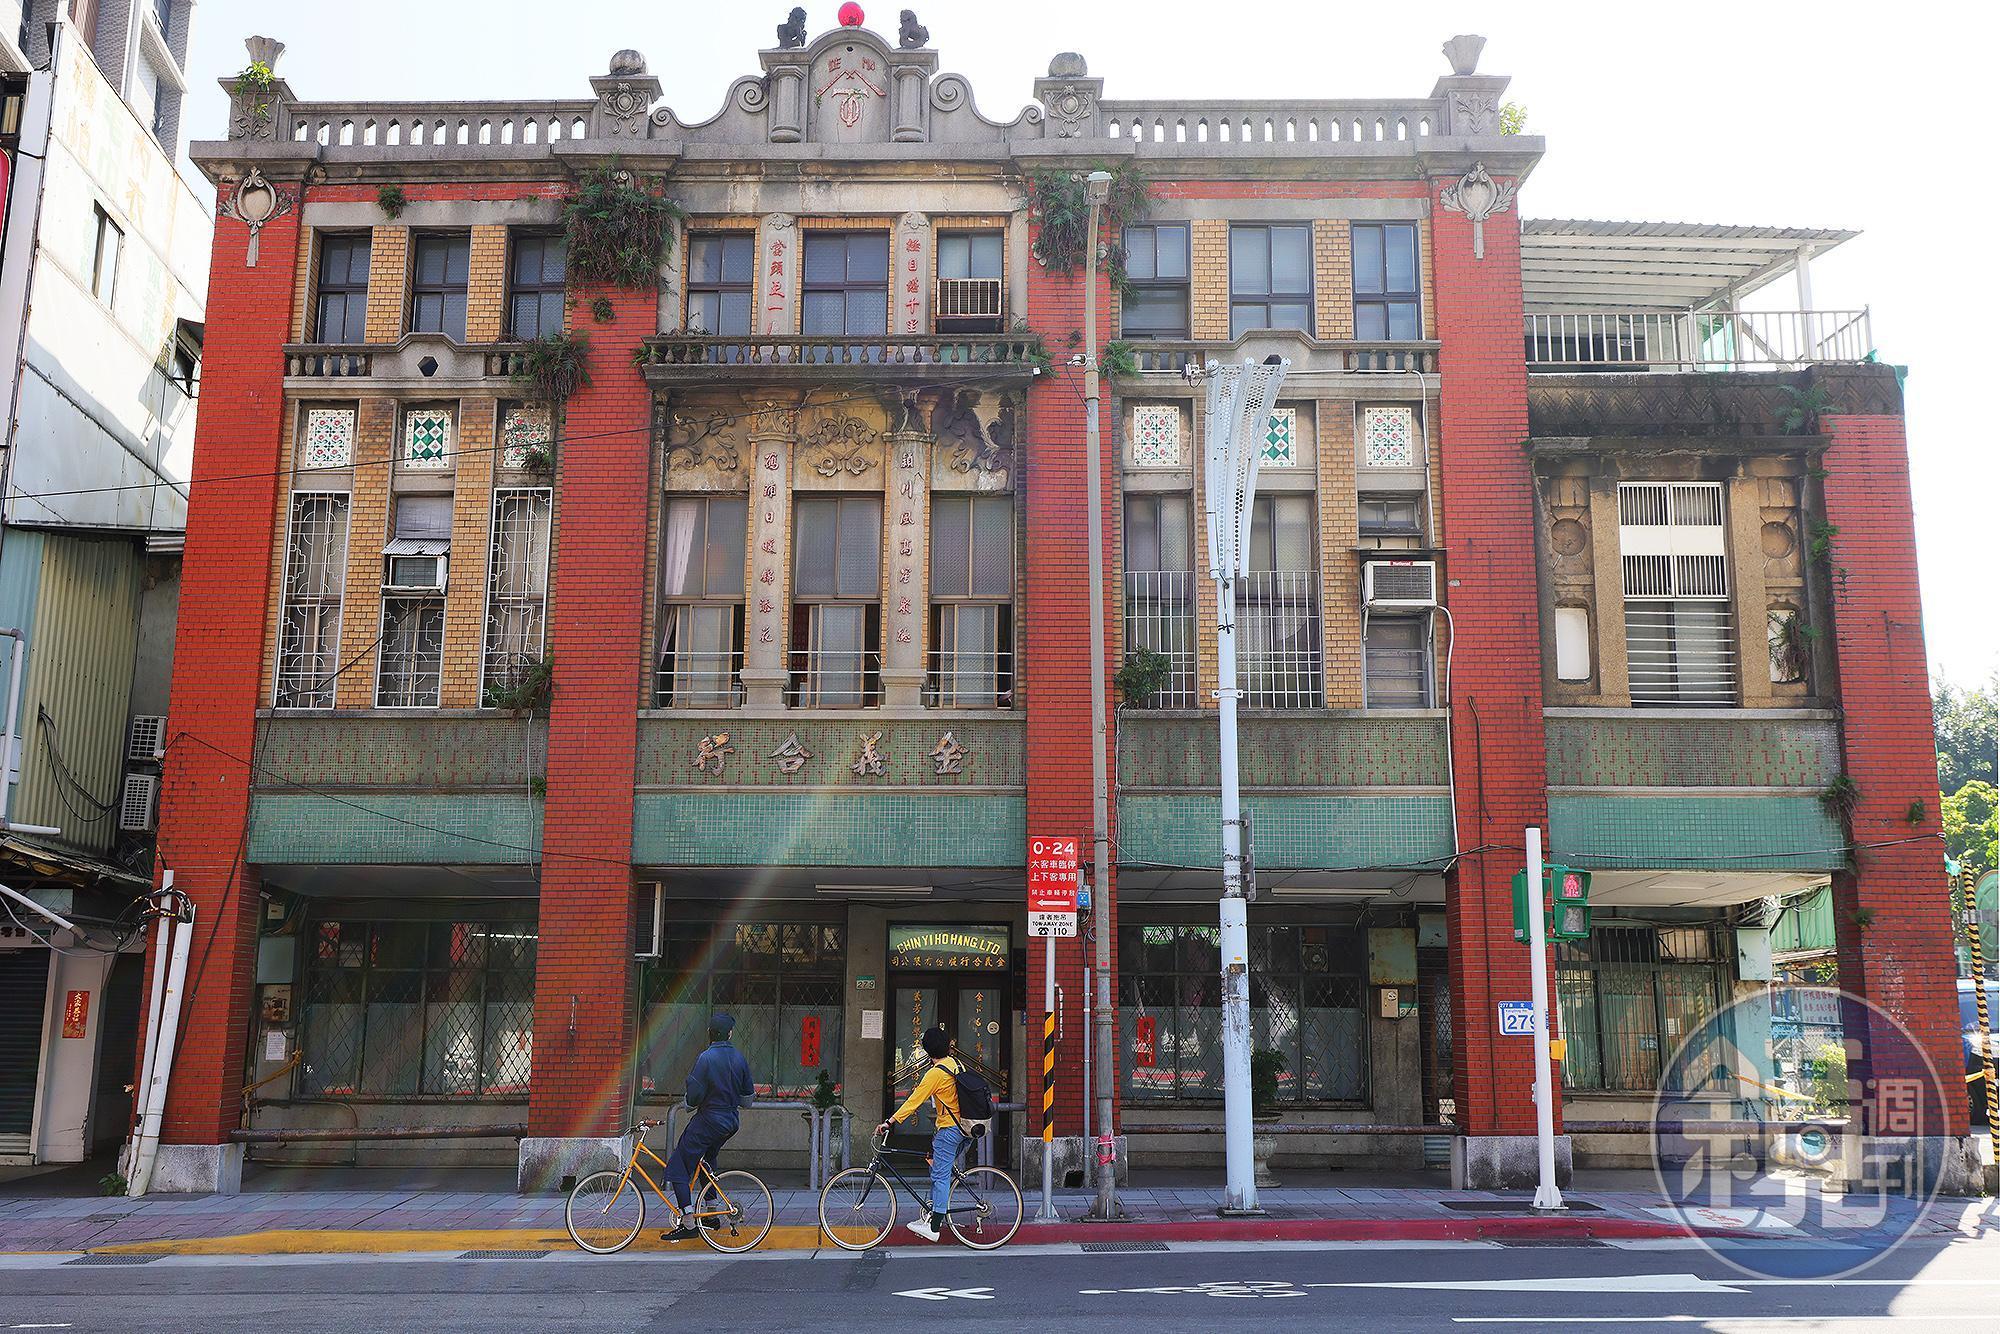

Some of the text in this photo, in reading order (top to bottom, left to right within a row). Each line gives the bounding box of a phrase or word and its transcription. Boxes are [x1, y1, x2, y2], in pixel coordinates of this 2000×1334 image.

[691, 731, 970, 777] 金義合行
[1033, 841, 1075, 855] 0-24
[1030, 860, 1076, 869] 大客車臨停
[1031, 872, 1077, 882] 上下客專用
[1053, 927, 1068, 936] 110
[896, 936, 921, 954] CHIN
[922, 934, 933, 946] YI
[934, 933, 949, 945] HO
